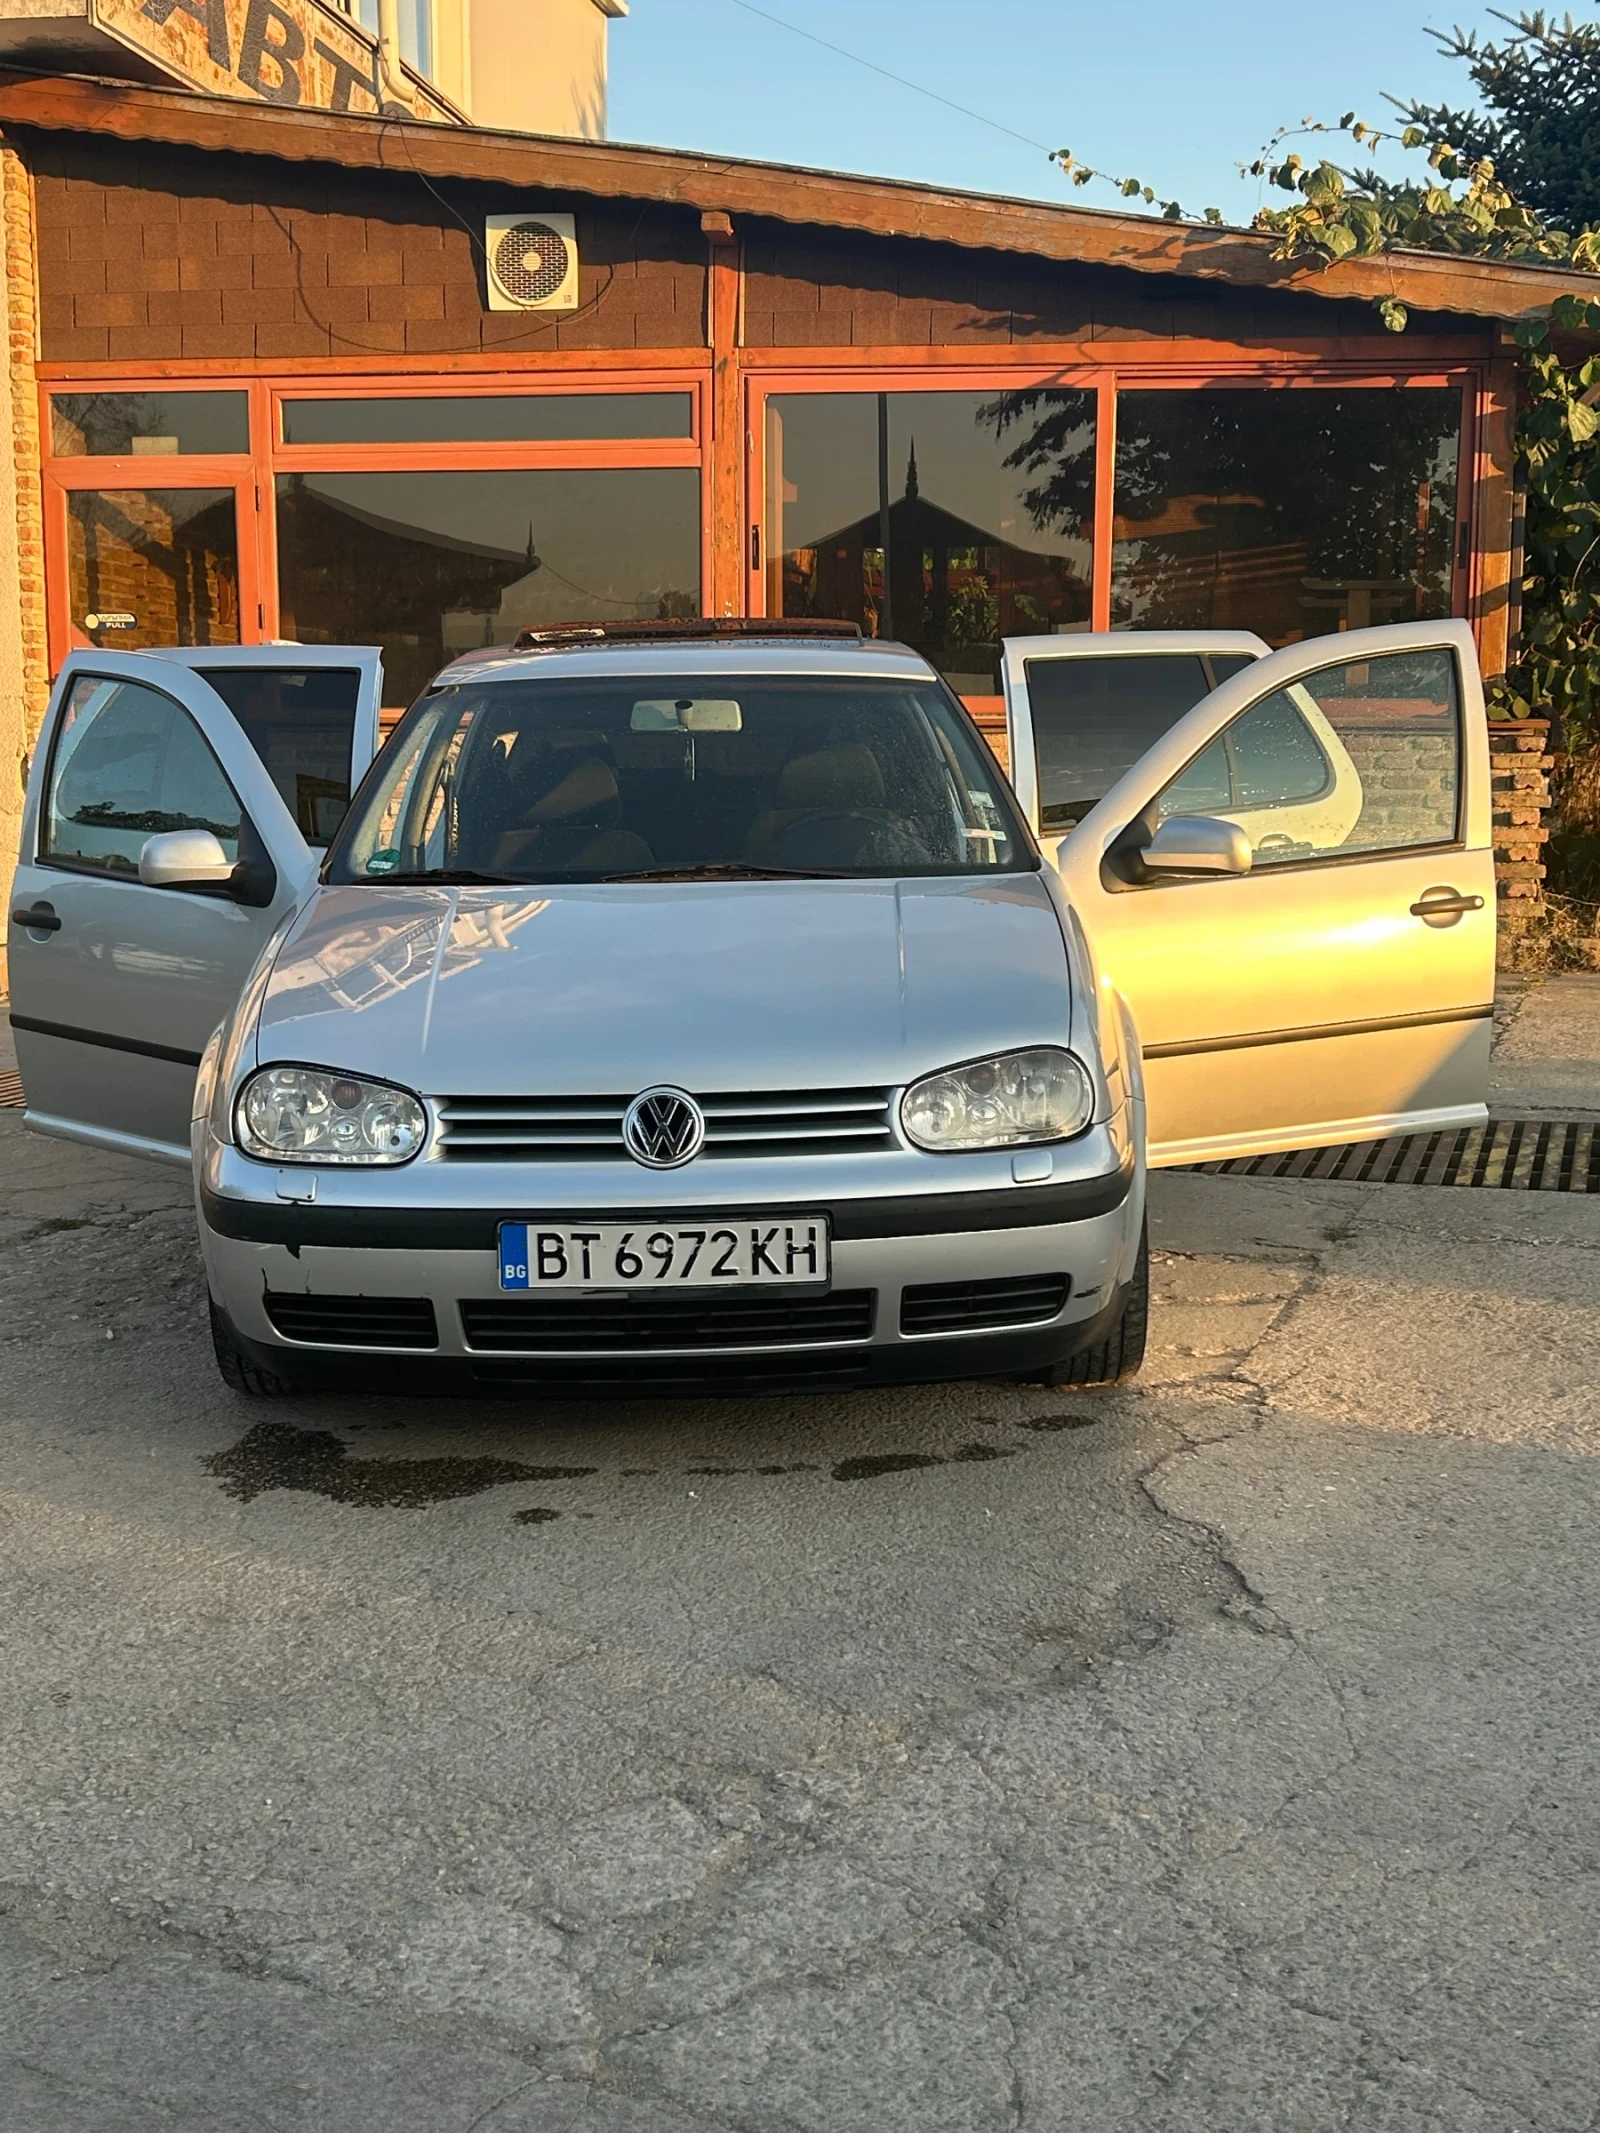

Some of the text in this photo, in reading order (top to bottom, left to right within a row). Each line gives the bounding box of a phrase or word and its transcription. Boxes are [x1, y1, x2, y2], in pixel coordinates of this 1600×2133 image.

[536, 1226, 818, 1280] BT 6972 KH
[504, 1264, 527, 1279] BG
